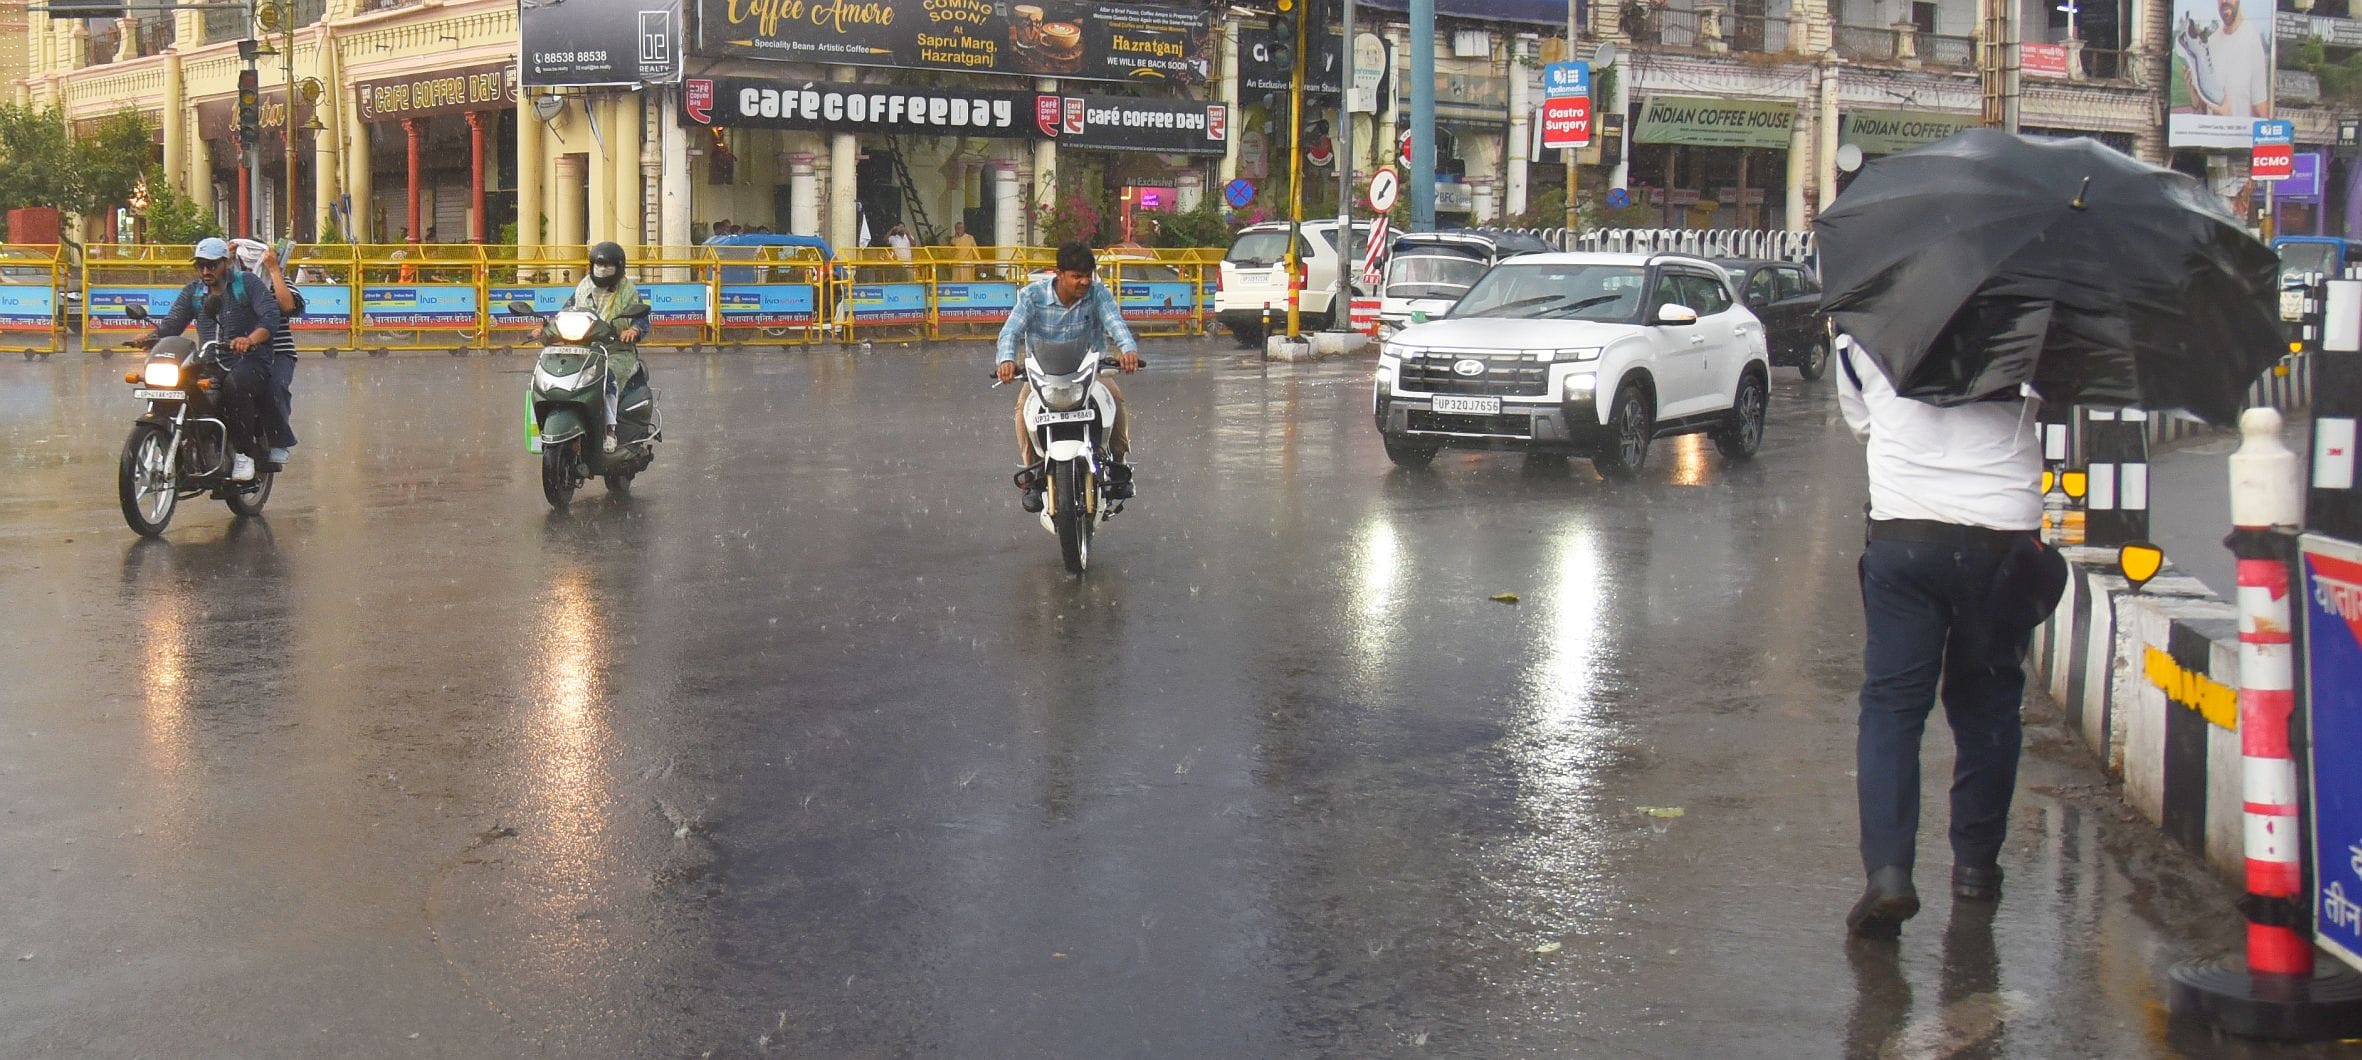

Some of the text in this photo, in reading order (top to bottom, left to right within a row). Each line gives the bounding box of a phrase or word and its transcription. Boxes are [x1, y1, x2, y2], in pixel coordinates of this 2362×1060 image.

[923, 0, 993, 15] COMING
[727, 0, 895, 36] Coffee Amore
[929, 10, 987, 26] SOON!
[754, 38, 870, 53] Speciality Beans Artistic Coffee
[917, 33, 998, 52] Sapru Marg,
[1112, 35, 1184, 57] Hazratganj
[544, 51, 607, 63] 88538 88538
[921, 48, 994, 67] Hazratganj
[1107, 57, 1118, 65] WE
[1119, 58, 1136, 66] WILL
[1148, 60, 1166, 68] BACK
[1167, 62, 1188, 70] SOON
[1246, 79, 1257, 87] An
[1258, 80, 1287, 89] Exclusive
[1547, 85, 1586, 97] Apollomedics
[1548, 108, 1584, 119] Gastro
[1648, 107, 1791, 129] INDIAN COFFEE HOUSE
[1546, 120, 1587, 133] Surgery
[1852, 118, 1899, 136] INDIAN
[1902, 122, 1951, 138] COFFEE
[2253, 157, 2289, 167] ECMO
